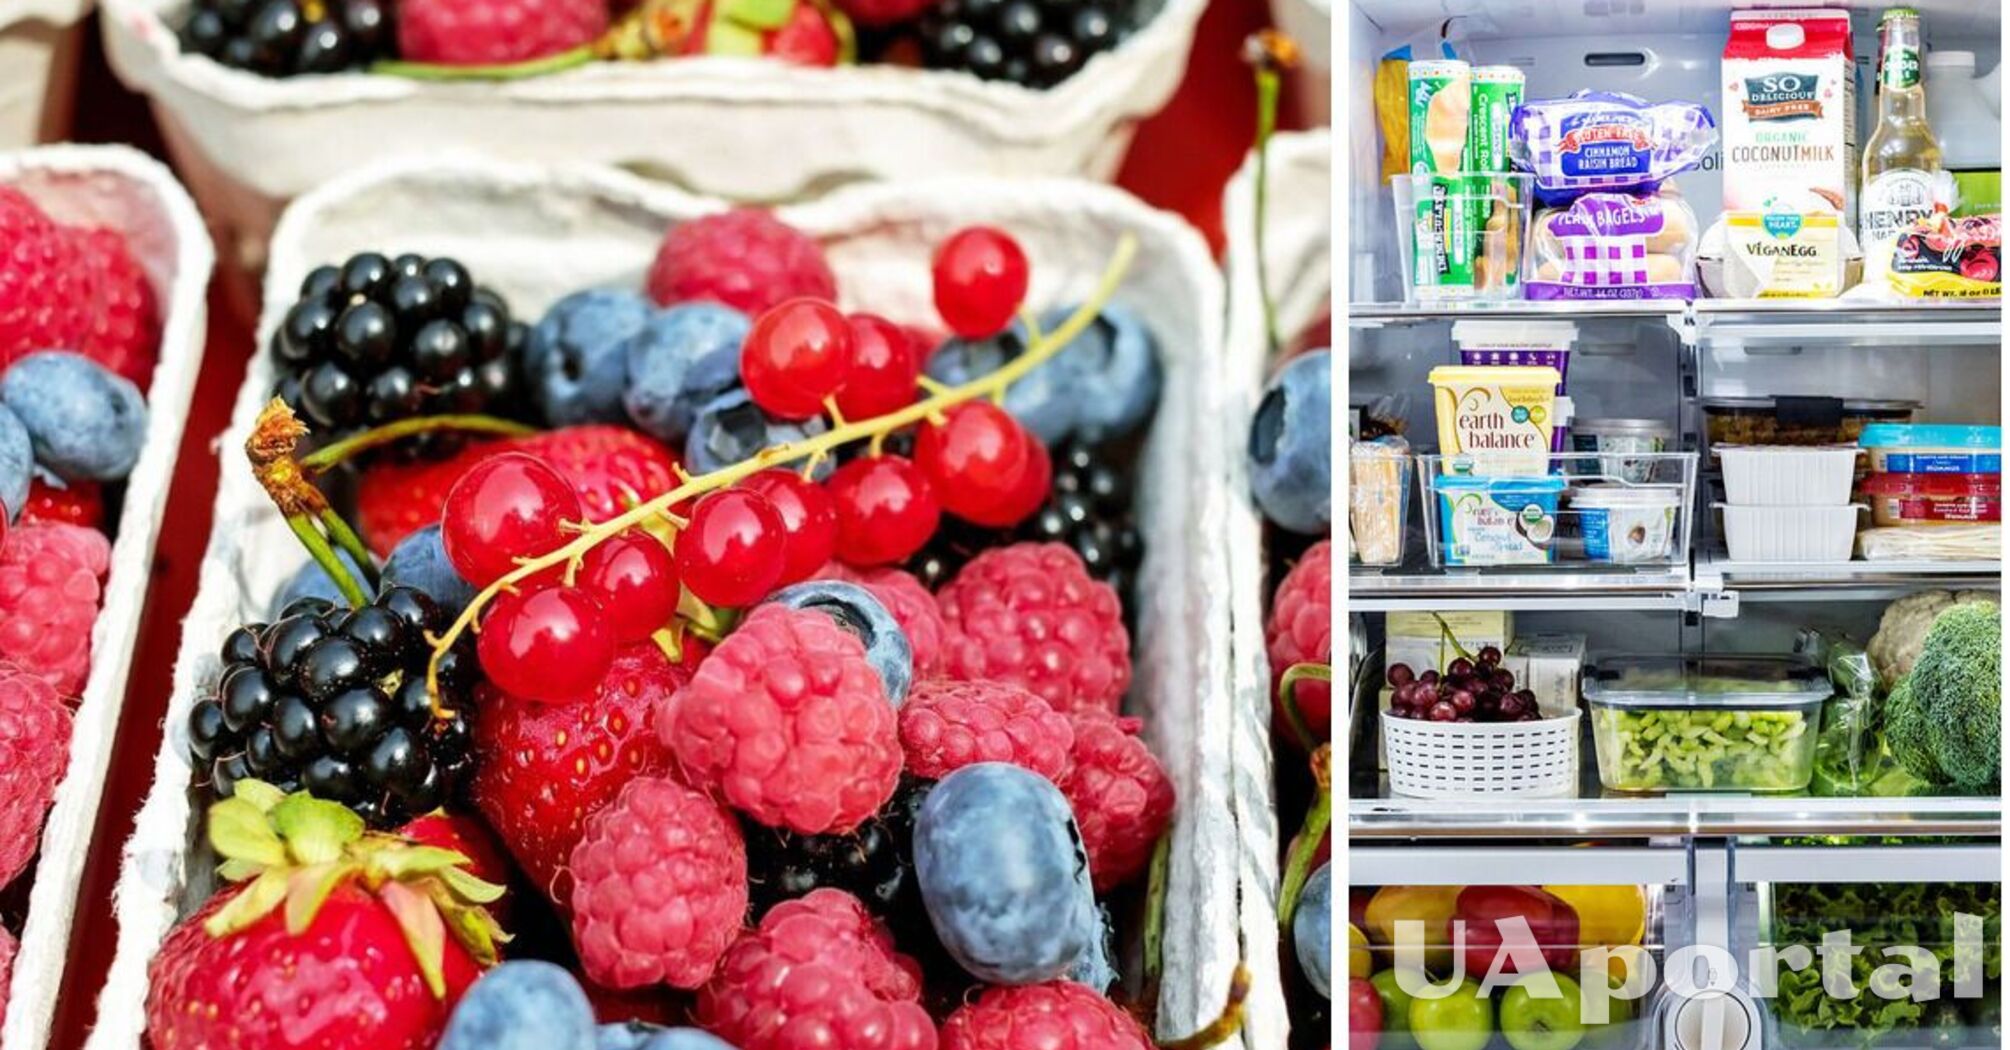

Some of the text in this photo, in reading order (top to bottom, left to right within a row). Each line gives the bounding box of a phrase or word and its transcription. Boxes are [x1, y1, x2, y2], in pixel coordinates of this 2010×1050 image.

[1762, 76, 1801, 93] SO
[1755, 103, 1809, 116] DAIRY FREE
[1478, 93, 1488, 147] Crescent
[1755, 131, 1807, 143] ORGANIC
[1584, 146, 1631, 159] CINNAMON
[1578, 156, 1639, 170] RAISIN BREAD
[1596, 206, 1645, 229] BAGELS
[1923, 289, 1940, 297] NET
[1459, 412, 1504, 430] earth
[1469, 431, 1535, 449] balance
